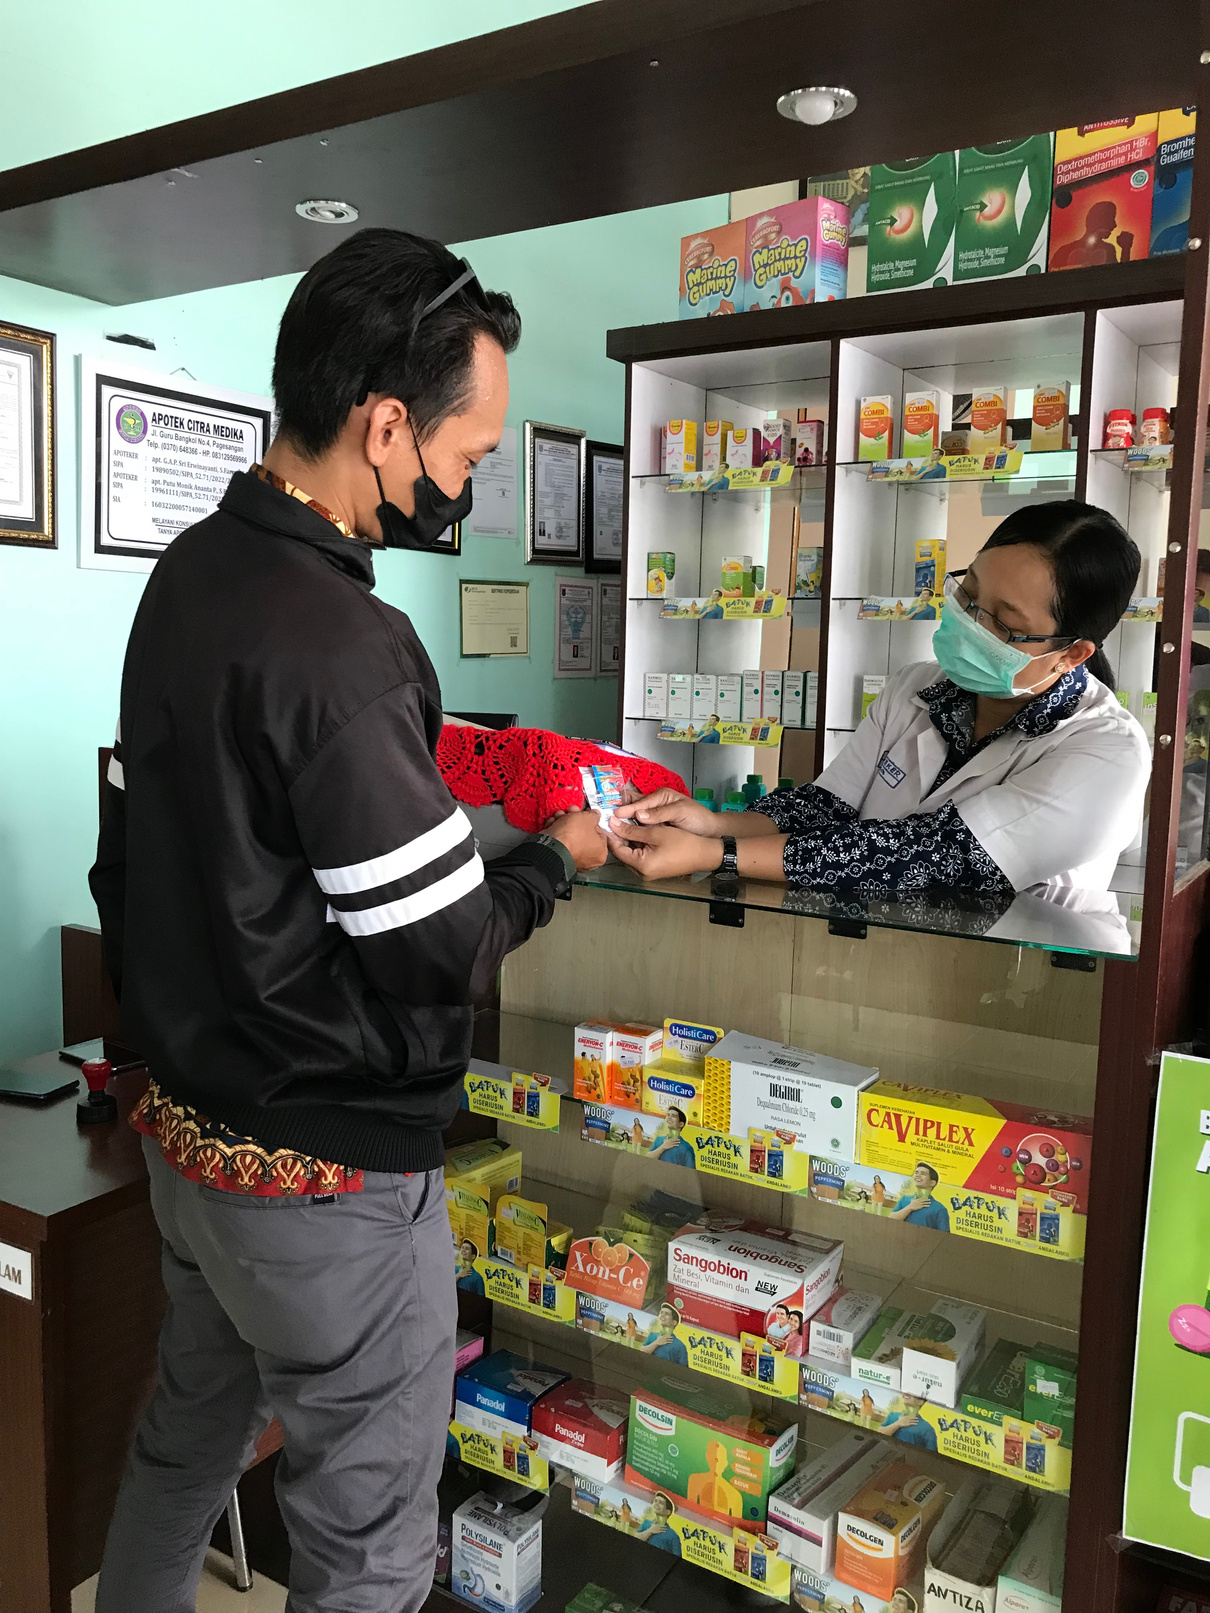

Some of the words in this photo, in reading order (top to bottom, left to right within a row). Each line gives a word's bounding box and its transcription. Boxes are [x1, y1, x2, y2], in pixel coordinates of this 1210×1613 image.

[1057, 143, 1131, 174] Dextromethorphan
[1056, 155, 1126, 185] Diphenhydramine
[753, 238, 808, 268] Marine
[985, 246, 1009, 258] Magnesium
[895, 258, 917, 268] Magnesium
[687, 259, 737, 288] Marine
[754, 256, 807, 288] Gummy
[689, 277, 735, 305] Gummy
[975, 401, 998, 409] COMBI
[1037, 395, 1060, 404] COMBI
[863, 409, 885, 417] COMBI
[908, 405, 930, 413] COMBI
[151, 412, 185, 430] APOTEK
[187, 418, 211, 435] CITRA
[213, 424, 244, 441] MEDIKA
[147, 440, 160, 449] Telp.
[161, 442, 178, 452] (0370)
[160, 431, 174, 440] Guru
[212, 440, 244, 453] Pagesangan
[113, 449, 139, 460] APOTEKER
[113, 460, 124, 468] SIPA
[113, 472, 138, 481] APOTEKER
[163, 479, 175, 487] Putu
[578, 1038, 603, 1047] ENERVON-C
[616, 1041, 642, 1051] ENERVON-C
[469, 1079, 508, 1101] BATUK
[479, 1092, 498, 1102] HARUS
[770, 1083, 802, 1103] DEGIROL
[473, 1098, 503, 1111] DISERIUSIN
[782, 1102, 799, 1116] Chloride
[586, 1119, 609, 1129] PEPPERMINT
[784, 1118, 801, 1126] LEMON
[867, 1108, 976, 1147] CAVIPLEX
[696, 1135, 743, 1159] BATUK
[911, 1141, 945, 1153] MULTIVITAMIN
[952, 1150, 975, 1159] MINERAL
[917, 1137, 936, 1145] KAPLET
[937, 1141, 954, 1149] SALUT
[700, 1155, 739, 1170] DISERIUSIN
[708, 1149, 731, 1161] HARUS
[815, 1176, 843, 1185] PEPPERMINT
[950, 1194, 1010, 1222] BATUK
[966, 1210, 994, 1223] HARUS
[956, 1217, 1003, 1234] DISERIUSIN
[571, 1251, 643, 1290] Xon-Ce
[674, 1247, 749, 1282] Sangobion
[485, 1266, 524, 1290] BATUK
[495, 1280, 514, 1291] HARUS
[673, 1264, 685, 1275] Zat
[686, 1269, 703, 1282] Besi,
[705, 1275, 733, 1289] Vitamin
[735, 1283, 750, 1295] dan
[673, 1273, 700, 1288] Mineral
[805, 1268, 830, 1295] Sangobion
[489, 1285, 519, 1300] DISERIUSIN
[757, 1280, 778, 1292] NEW
[688, 1334, 735, 1361] BATUK
[700, 1349, 723, 1362] HARUS
[693, 1355, 731, 1372] DISERIUSIN
[858, 1367, 890, 1380] natur-e
[805, 1383, 832, 1396] PEPPERMINT
[477, 1393, 505, 1412] Panadol
[639, 1405, 673, 1426] DECOLSIN
[555, 1424, 585, 1443] Panadol
[953, 1432, 981, 1448] HARUS
[470, 1444, 488, 1456] HARUS
[944, 1438, 990, 1460] DISERIUSIN
[465, 1449, 495, 1465] DISERIUSIN
[461, 1523, 503, 1552] POLYSILANE
[846, 1524, 884, 1547] DECOLGEN
[694, 1540, 716, 1555] HARUS
[686, 1545, 723, 1566] DISERIUSIN
